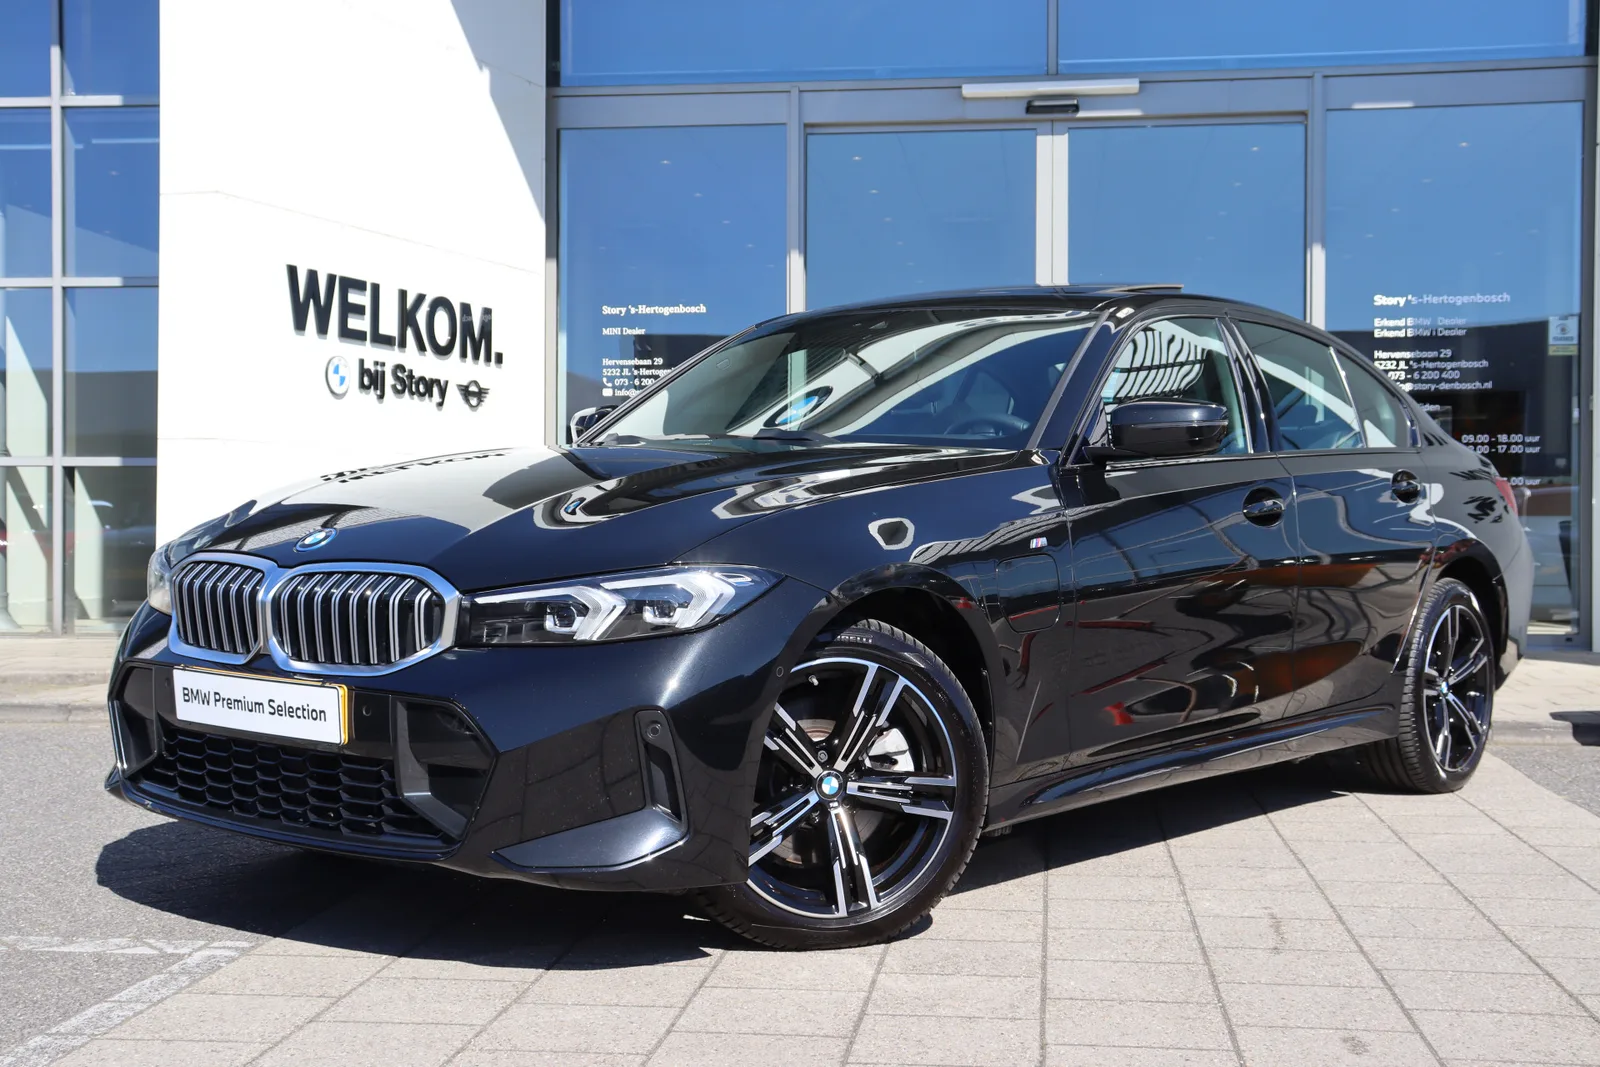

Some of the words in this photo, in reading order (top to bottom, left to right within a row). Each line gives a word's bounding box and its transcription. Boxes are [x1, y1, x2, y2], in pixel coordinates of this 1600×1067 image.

[1373, 294, 1407, 307] Story
[286, 264, 503, 365] WELKOM.
[602, 305, 627, 316] Story
[1374, 317, 1405, 327] Erkend
[1437, 317, 1467, 326] Dealer
[622, 327, 646, 335] Dealer
[1374, 328, 1405, 338] Erkend
[1437, 328, 1467, 336] Dealer
[1373, 350, 1438, 359] Hervensebaan
[1439, 349, 1452, 358] 29
[602, 358, 652, 366] Hervensebaan
[653, 357, 663, 365] 29
[602, 368, 621, 376] 5232
[1413, 371, 1420, 379] 6
[1421, 371, 1440, 380] 200
[1441, 370, 1460, 379] 400
[358, 358, 386, 401] bij
[391, 364, 449, 407] Story
[614, 378, 629, 386] 073
[1461, 434, 1490, 443] 09.00
[1497, 433, 1523, 443] 18.00
[1525, 435, 1541, 443] uur
[1525, 478, 1541, 486] uur
[182, 687, 211, 707] BMW
[214, 692, 265, 715] Premium
[268, 698, 327, 722] Selection
